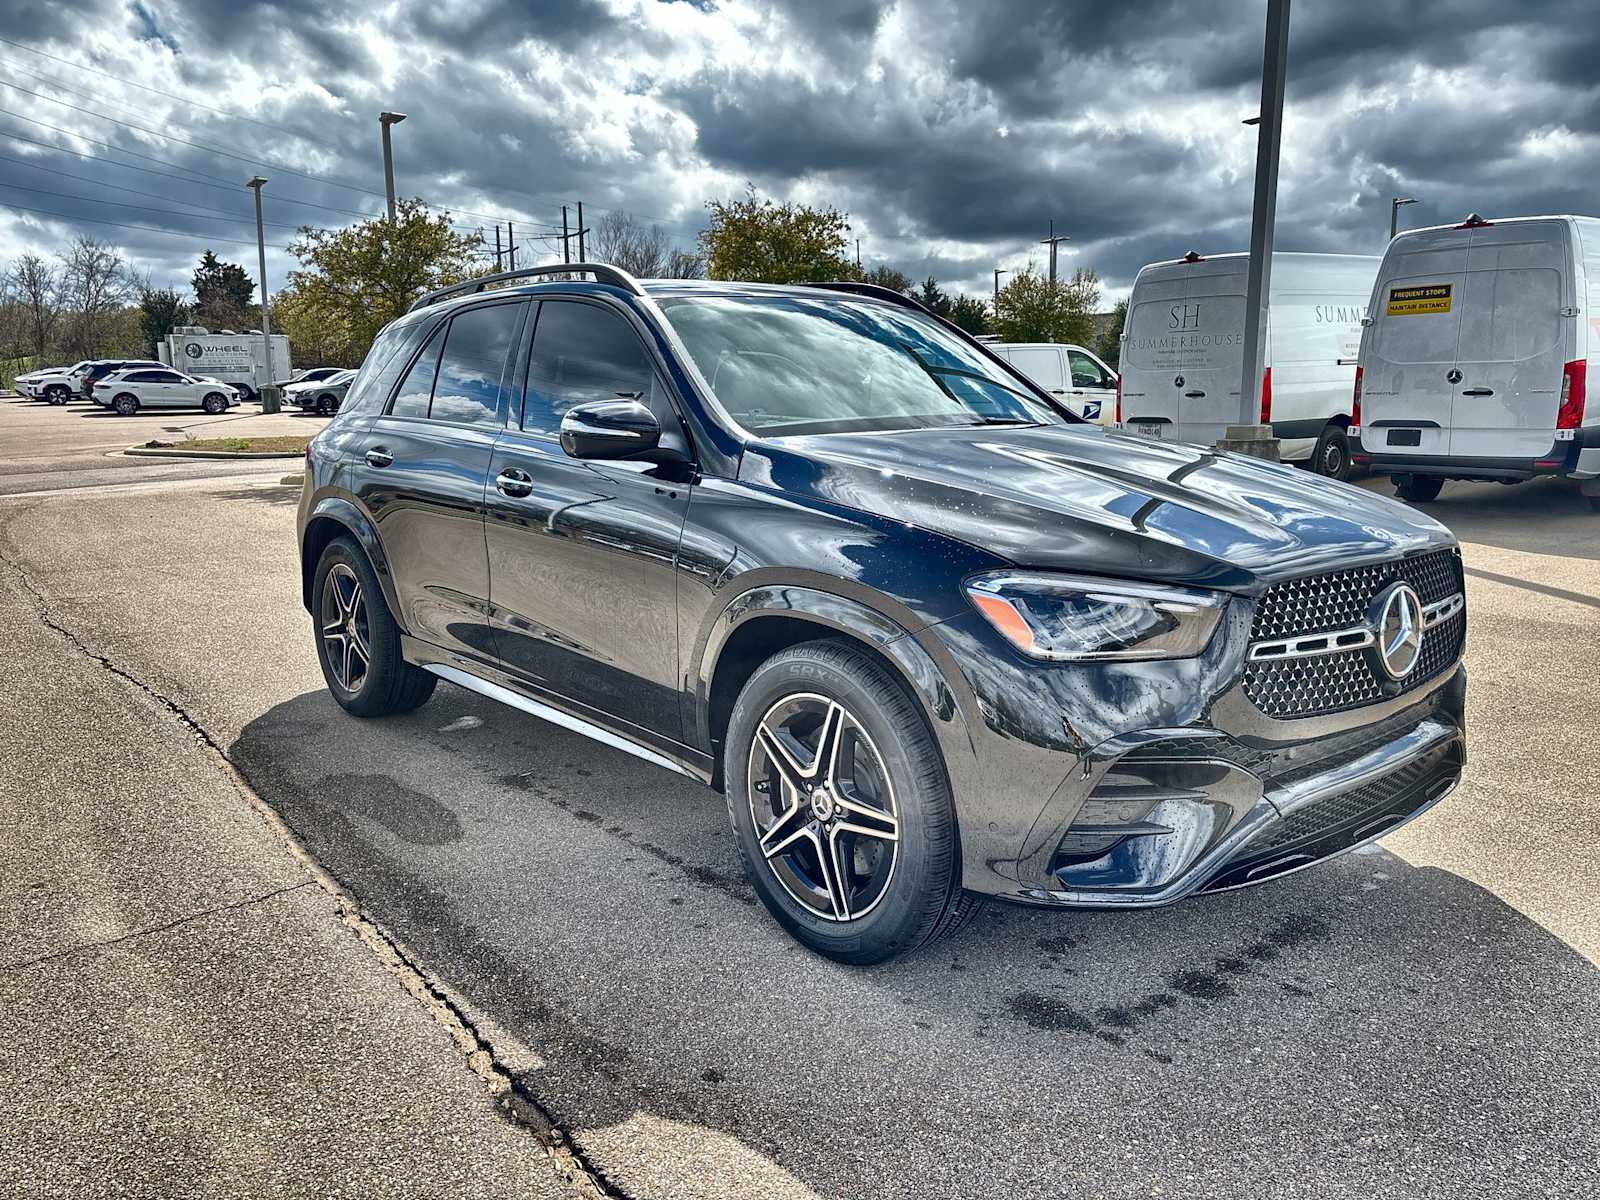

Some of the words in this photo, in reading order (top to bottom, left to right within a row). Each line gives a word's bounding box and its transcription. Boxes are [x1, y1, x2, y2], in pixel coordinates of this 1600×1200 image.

[1394, 289, 1424, 298] FREQUENT
[1425, 288, 1447, 296] STOPS
[1390, 303, 1417, 311] MAINTAIN
[1418, 301, 1448, 309] DISTANCE
[1168, 303, 1200, 329] SH
[1131, 334, 1242, 350] SUMMERHOUSE
